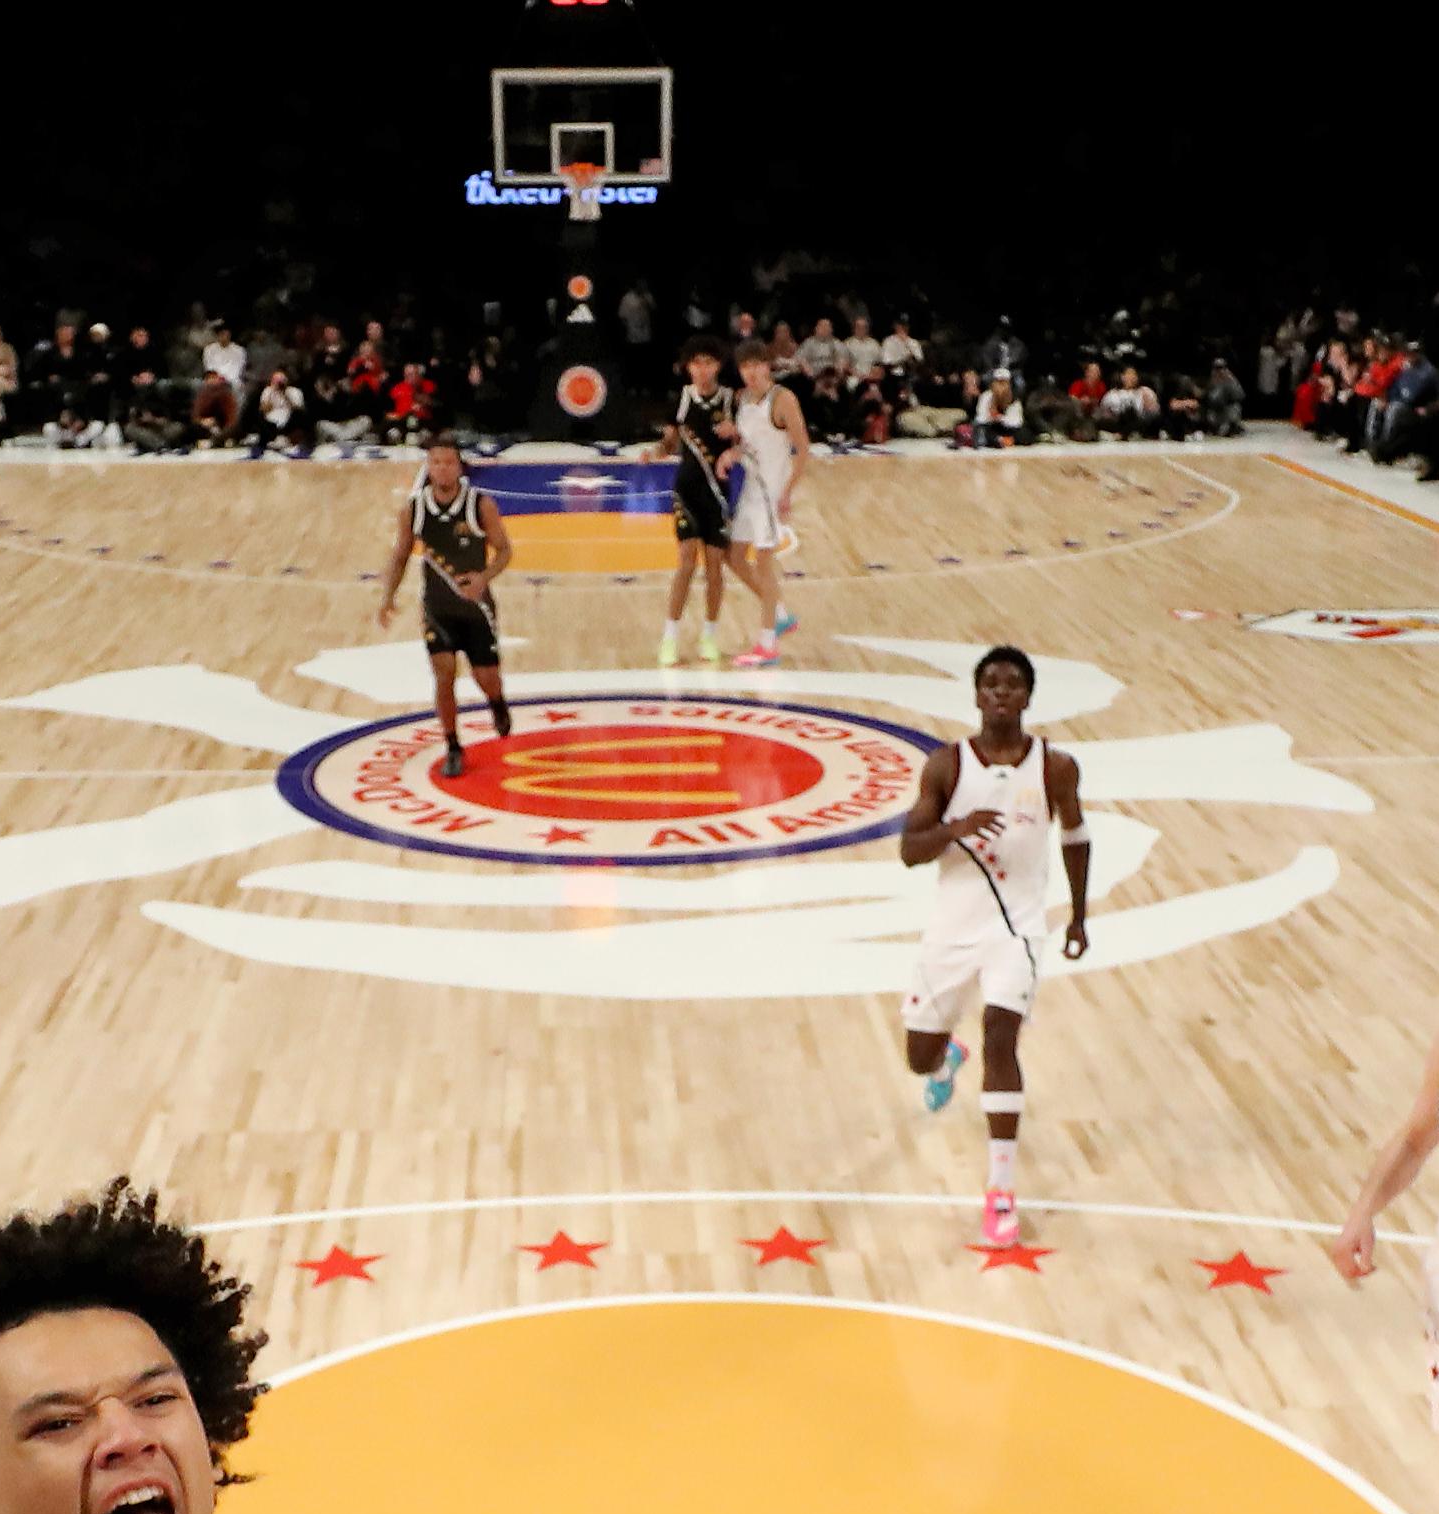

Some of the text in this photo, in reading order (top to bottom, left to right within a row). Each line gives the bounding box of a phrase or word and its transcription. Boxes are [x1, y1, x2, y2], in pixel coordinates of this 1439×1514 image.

[352, 718, 497, 833] McDonalds
[628, 704, 915, 849] All American Games
